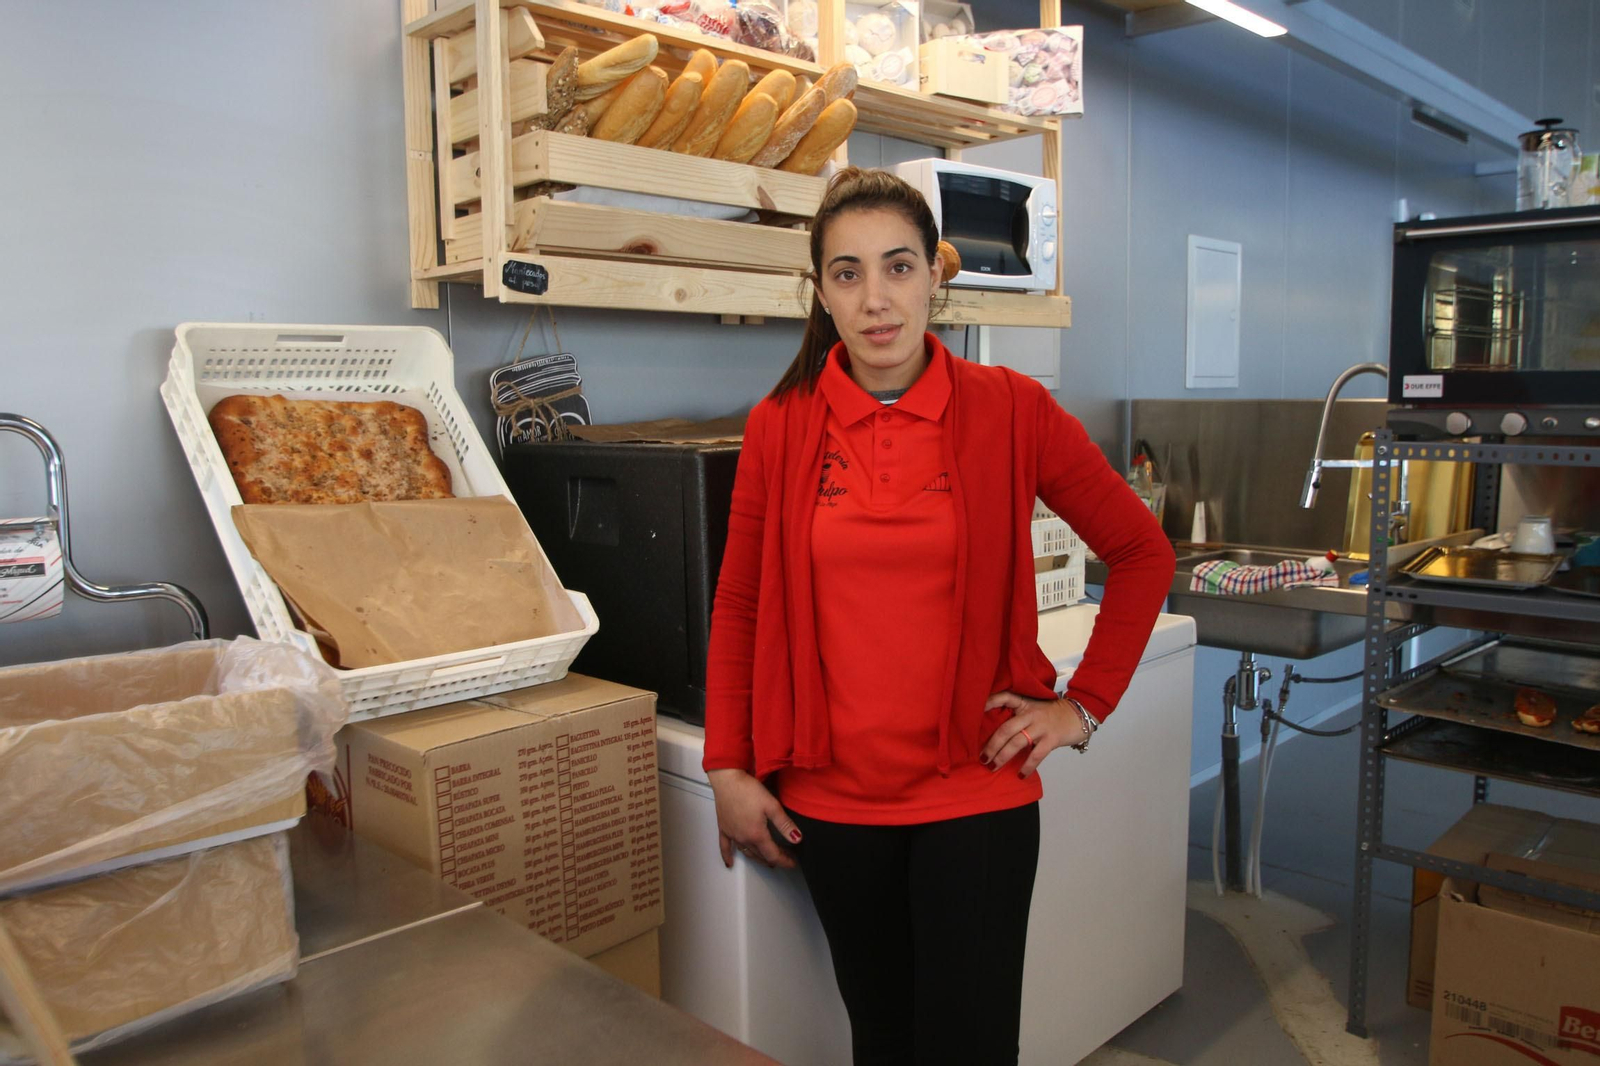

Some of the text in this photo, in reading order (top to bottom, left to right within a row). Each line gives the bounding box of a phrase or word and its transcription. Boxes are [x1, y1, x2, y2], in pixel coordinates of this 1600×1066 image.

[570, 729, 600, 743] BAGUETTINA
[571, 741, 600, 755] BAGUETTINA
[600, 735, 623, 746] INTEGRAL
[472, 768, 501, 782] INTEGRAL
[1443, 990, 1488, 1012] 210448
[1562, 1014, 1600, 1041] Be
